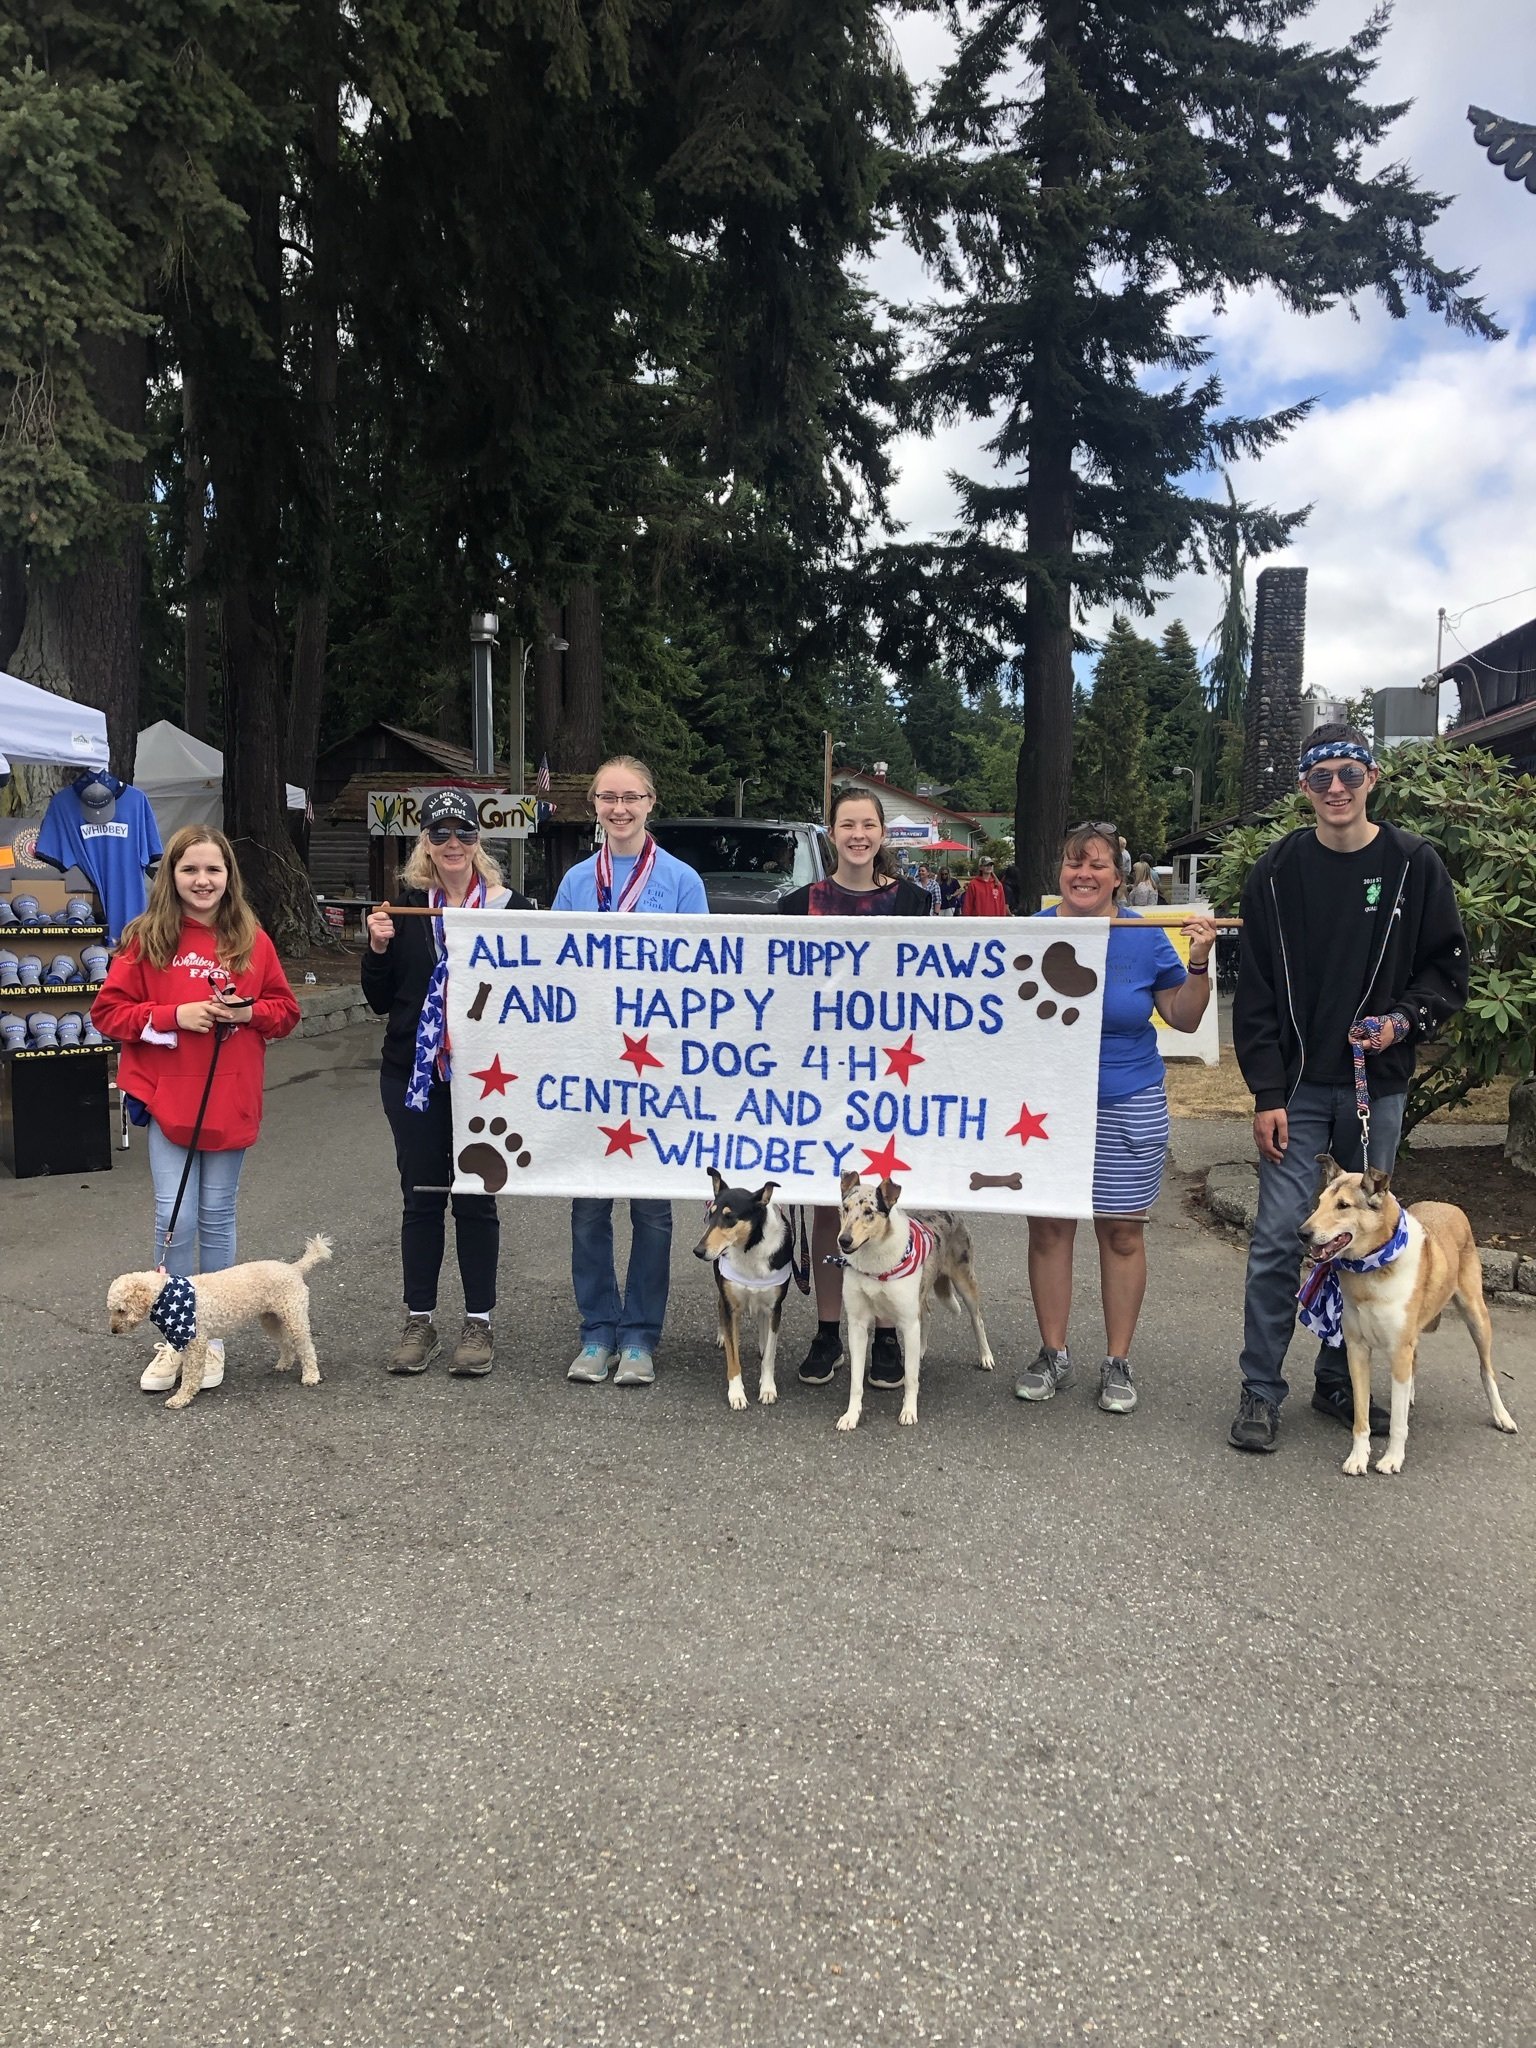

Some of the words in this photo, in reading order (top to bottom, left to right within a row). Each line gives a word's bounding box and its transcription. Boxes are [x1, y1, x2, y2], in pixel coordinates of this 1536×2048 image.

[429, 797, 439, 809] ALL
[440, 792, 468, 807] AMERICAN
[432, 808, 449, 819] PUPPY
[450, 808, 466, 816] PAWS
[478, 798, 525, 829] Corn
[82, 823, 127, 836] WHIDBEY
[172, 951, 215, 970] Whidbey
[470, 934, 541, 968] ALL
[557, 933, 745, 975] AMERICAN
[768, 939, 869, 977] PUPPY
[897, 939, 1006, 979] PAWS
[0, 986, 26, 995] MADE
[28, 986, 41, 994] ON
[44, 984, 85, 993] WHIDBEY
[500, 984, 577, 1024] AND
[615, 986, 774, 1031] HAPPY
[814, 990, 1004, 1035] HOUNDS
[15, 1050, 56, 1058] GRAB
[59, 1047, 91, 1055] AND
[682, 1039, 777, 1078] DOG
[802, 1045, 877, 1082] 4-H
[537, 1074, 717, 1121] CENTRAL
[735, 1087, 822, 1127] AND
[846, 1089, 988, 1141] SOUTH
[647, 1128, 854, 1177] WHIDBEY
